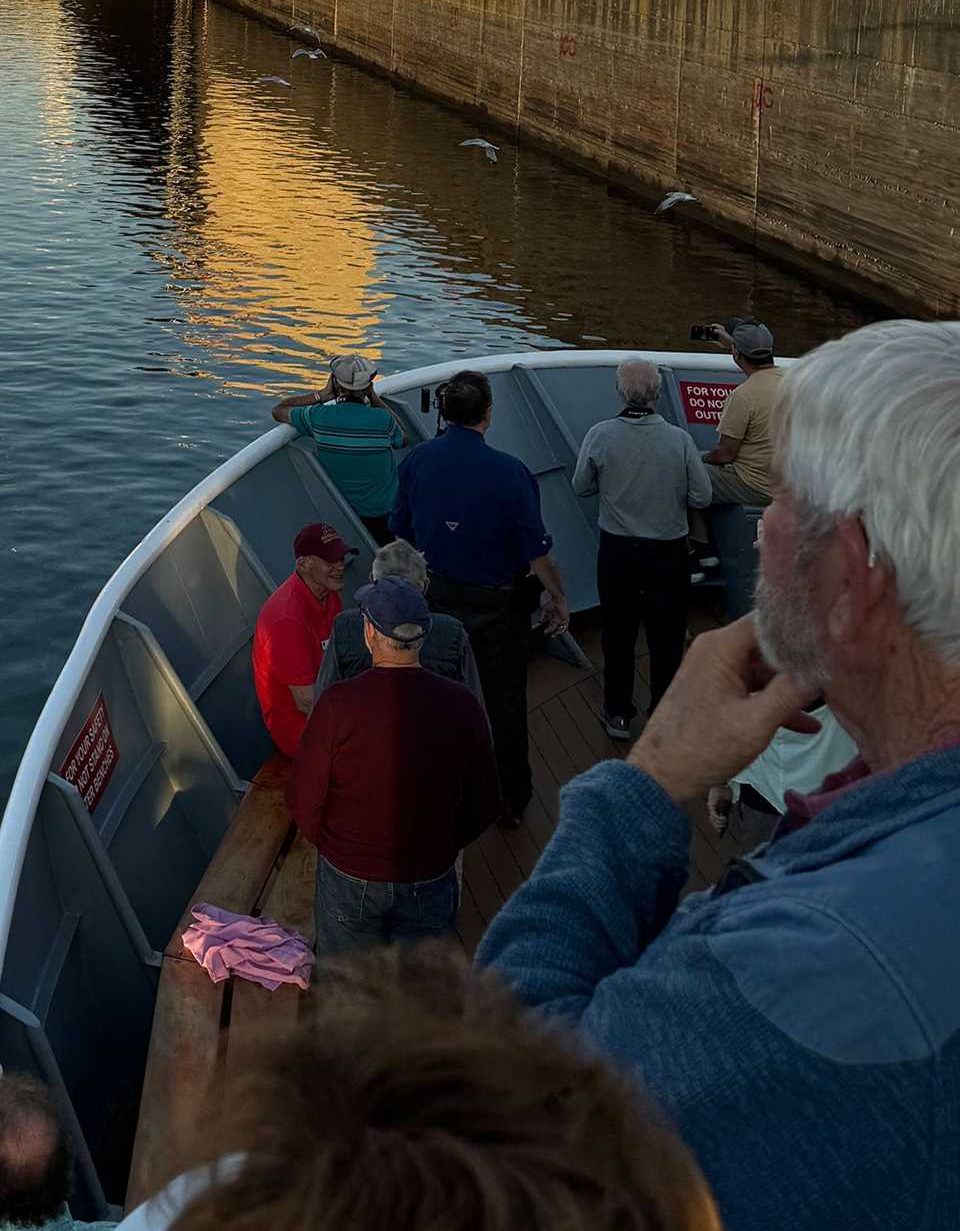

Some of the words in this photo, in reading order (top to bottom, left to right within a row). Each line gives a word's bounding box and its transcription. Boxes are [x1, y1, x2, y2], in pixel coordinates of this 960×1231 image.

[686, 386, 709, 397] FOR
[710, 388, 734, 398] YOU
[689, 398, 705, 408] DO
[707, 399, 725, 409] NO
[65, 759, 78, 781] FOR
[74, 735, 91, 766] YOUR
